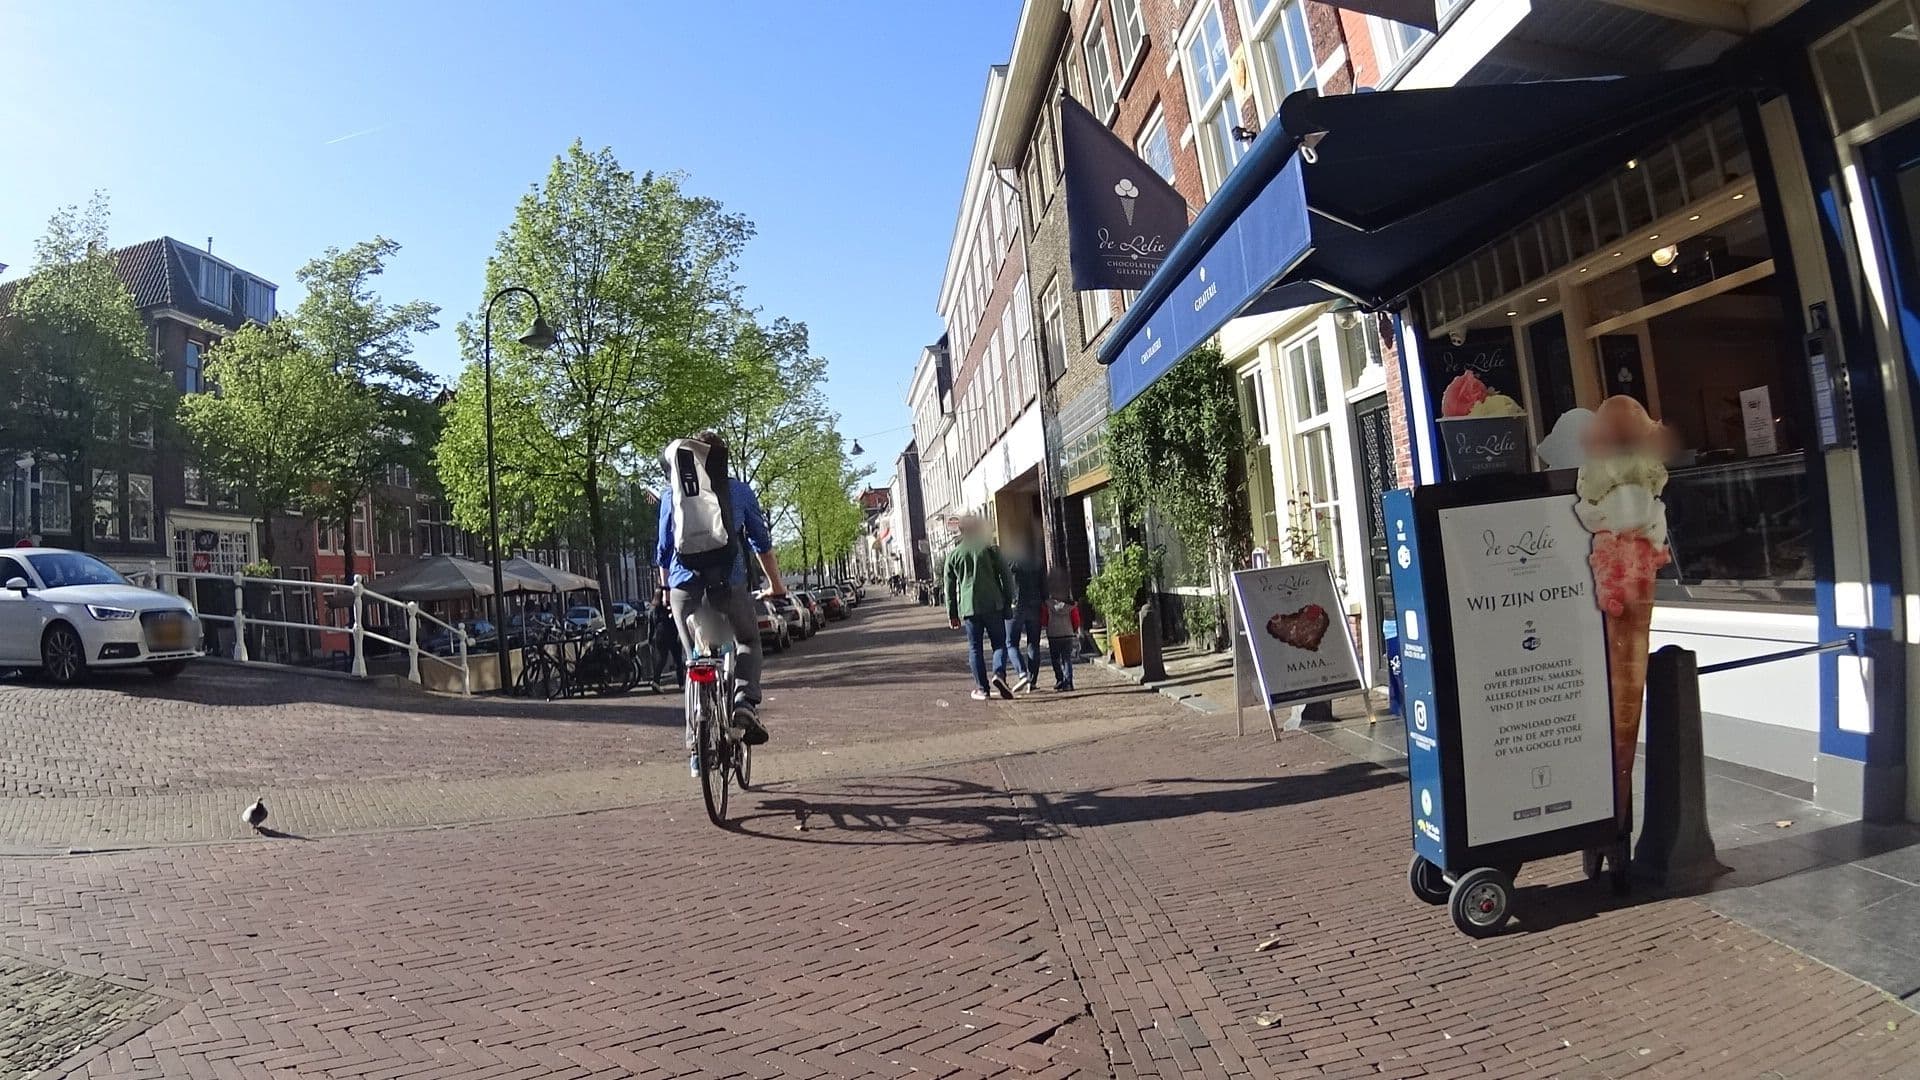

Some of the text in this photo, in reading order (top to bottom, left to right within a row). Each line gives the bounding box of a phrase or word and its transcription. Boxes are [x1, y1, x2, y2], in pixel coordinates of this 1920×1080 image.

[1098, 227, 1166, 255] de Lelie
[1107, 260, 1160, 269] CHOCOLATERI
[1195, 281, 1217, 311] GELATERIE
[1456, 431, 1514, 455] de Lelie
[1483, 525, 1556, 556] de Lelie
[1259, 575, 1273, 592] de
[1467, 582, 1584, 611] WIJ ZIJN OPEN!
[1495, 659, 1572, 678] MEER INFORMATIE
[1484, 680, 1508, 690] OVER
[1485, 679, 1585, 702] ALLERGENEN EN ACTIES
[1490, 702, 1514, 713] VIND
[1516, 700, 1525, 710] JE
[1527, 698, 1537, 708] IN
[1539, 694, 1562, 705] ONZE
[1499, 713, 1577, 734] DOWNLOAD ONZE
[1494, 723, 1583, 748] APP IN DE APP STORE
[1495, 734, 1582, 758] OF VIA GOOGLE PLAY
